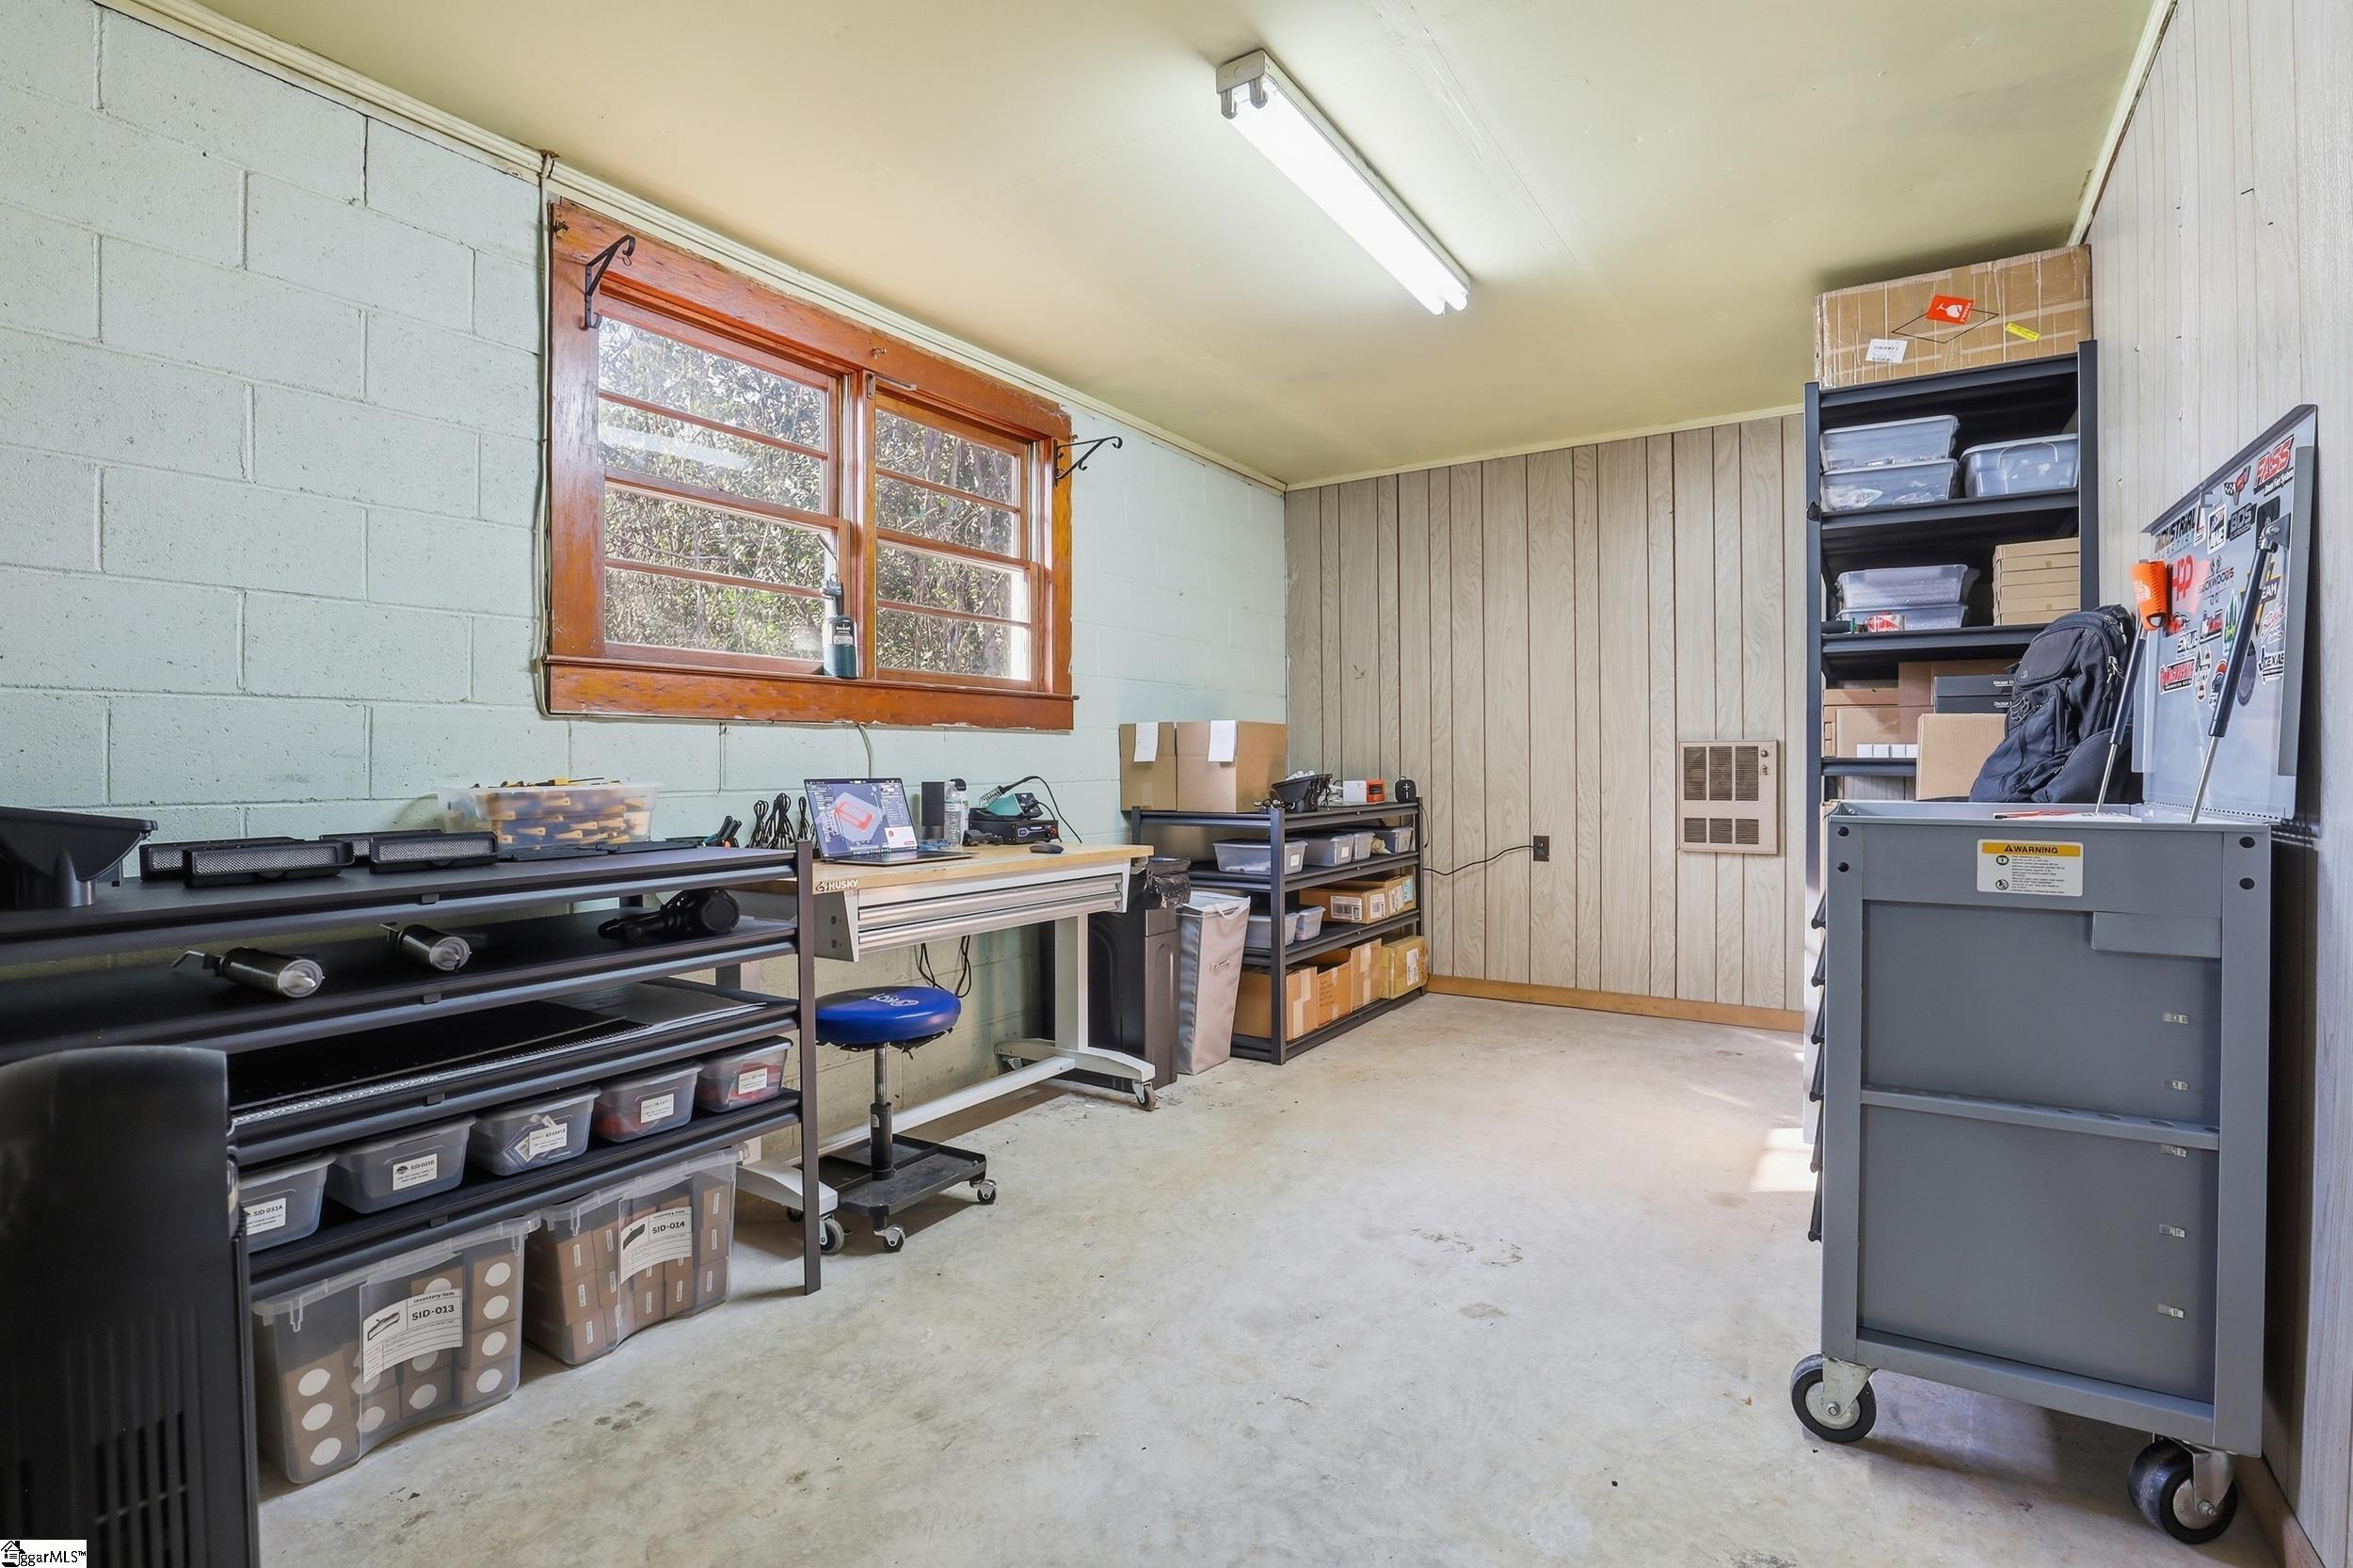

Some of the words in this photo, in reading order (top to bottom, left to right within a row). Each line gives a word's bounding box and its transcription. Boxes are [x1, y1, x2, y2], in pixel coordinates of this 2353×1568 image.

[2256, 436, 2294, 486] FASS
[2013, 846, 2058, 855] WARNING
[828, 879, 858, 890] HUSKY
[652, 1221, 685, 1235] SID-014
[411, 1304, 455, 1321] SID-013
